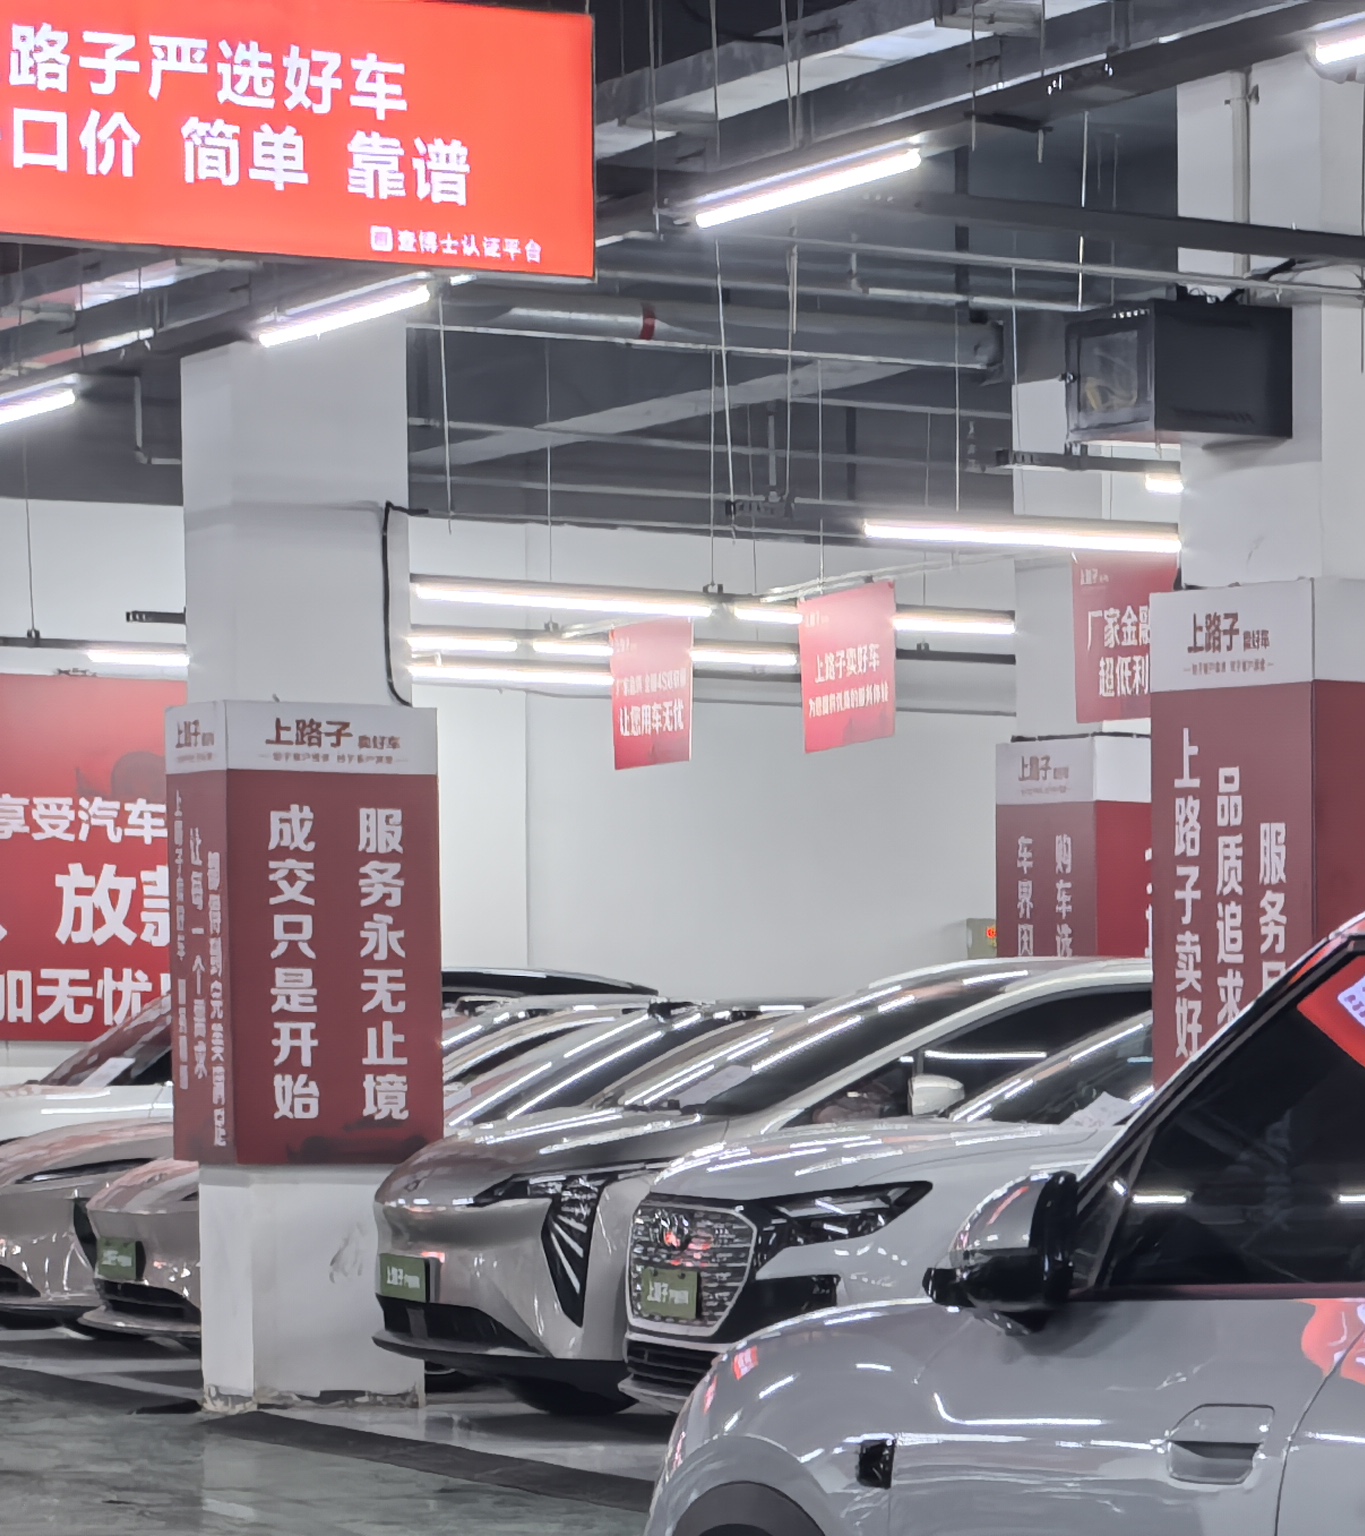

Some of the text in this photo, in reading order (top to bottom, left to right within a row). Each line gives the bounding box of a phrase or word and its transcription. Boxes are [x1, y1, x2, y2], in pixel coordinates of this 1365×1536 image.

[9, 22, 408, 121] 路子严选好车
[12, 107, 470, 206] 口价 简单 靠谱
[1099, 653, 1149, 697] 超低利
[1187, 612, 1240, 653] 上路子
[265, 718, 353, 748] 上路子
[1174, 727, 1202, 1059] 上路子卖好
[1216, 766, 1244, 1027] 品质追求
[268, 804, 320, 1120] 成交只是开始
[358, 807, 409, 1121] 服务永无止境
